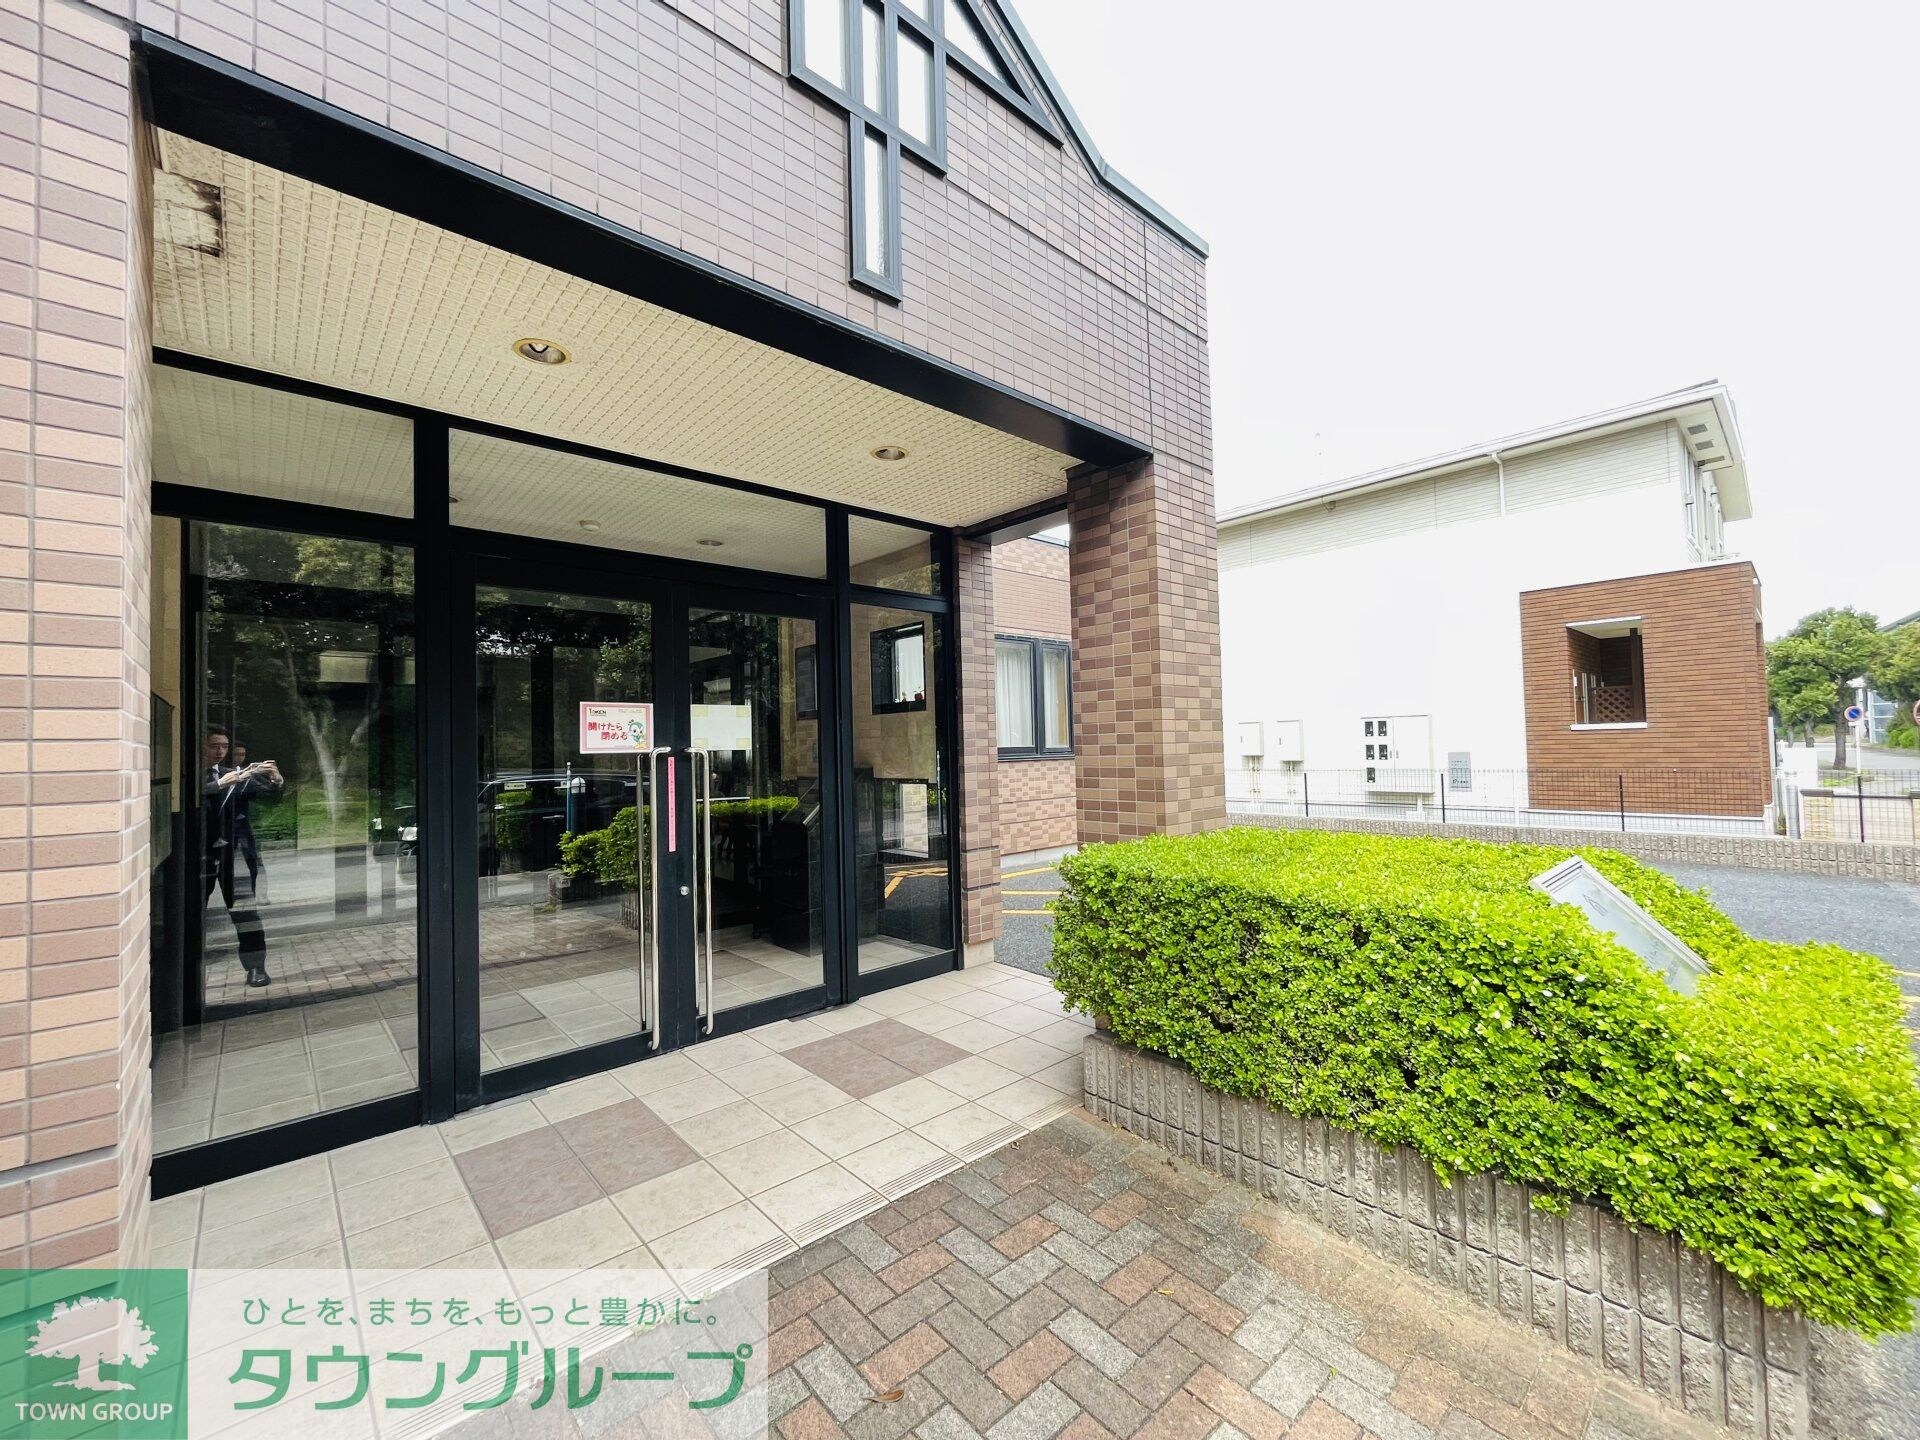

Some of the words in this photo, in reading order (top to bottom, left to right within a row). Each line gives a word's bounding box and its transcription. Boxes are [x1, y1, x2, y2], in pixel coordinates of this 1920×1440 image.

[588, 722, 623, 731] 開けたら
[601, 732, 628, 740] 閉める
